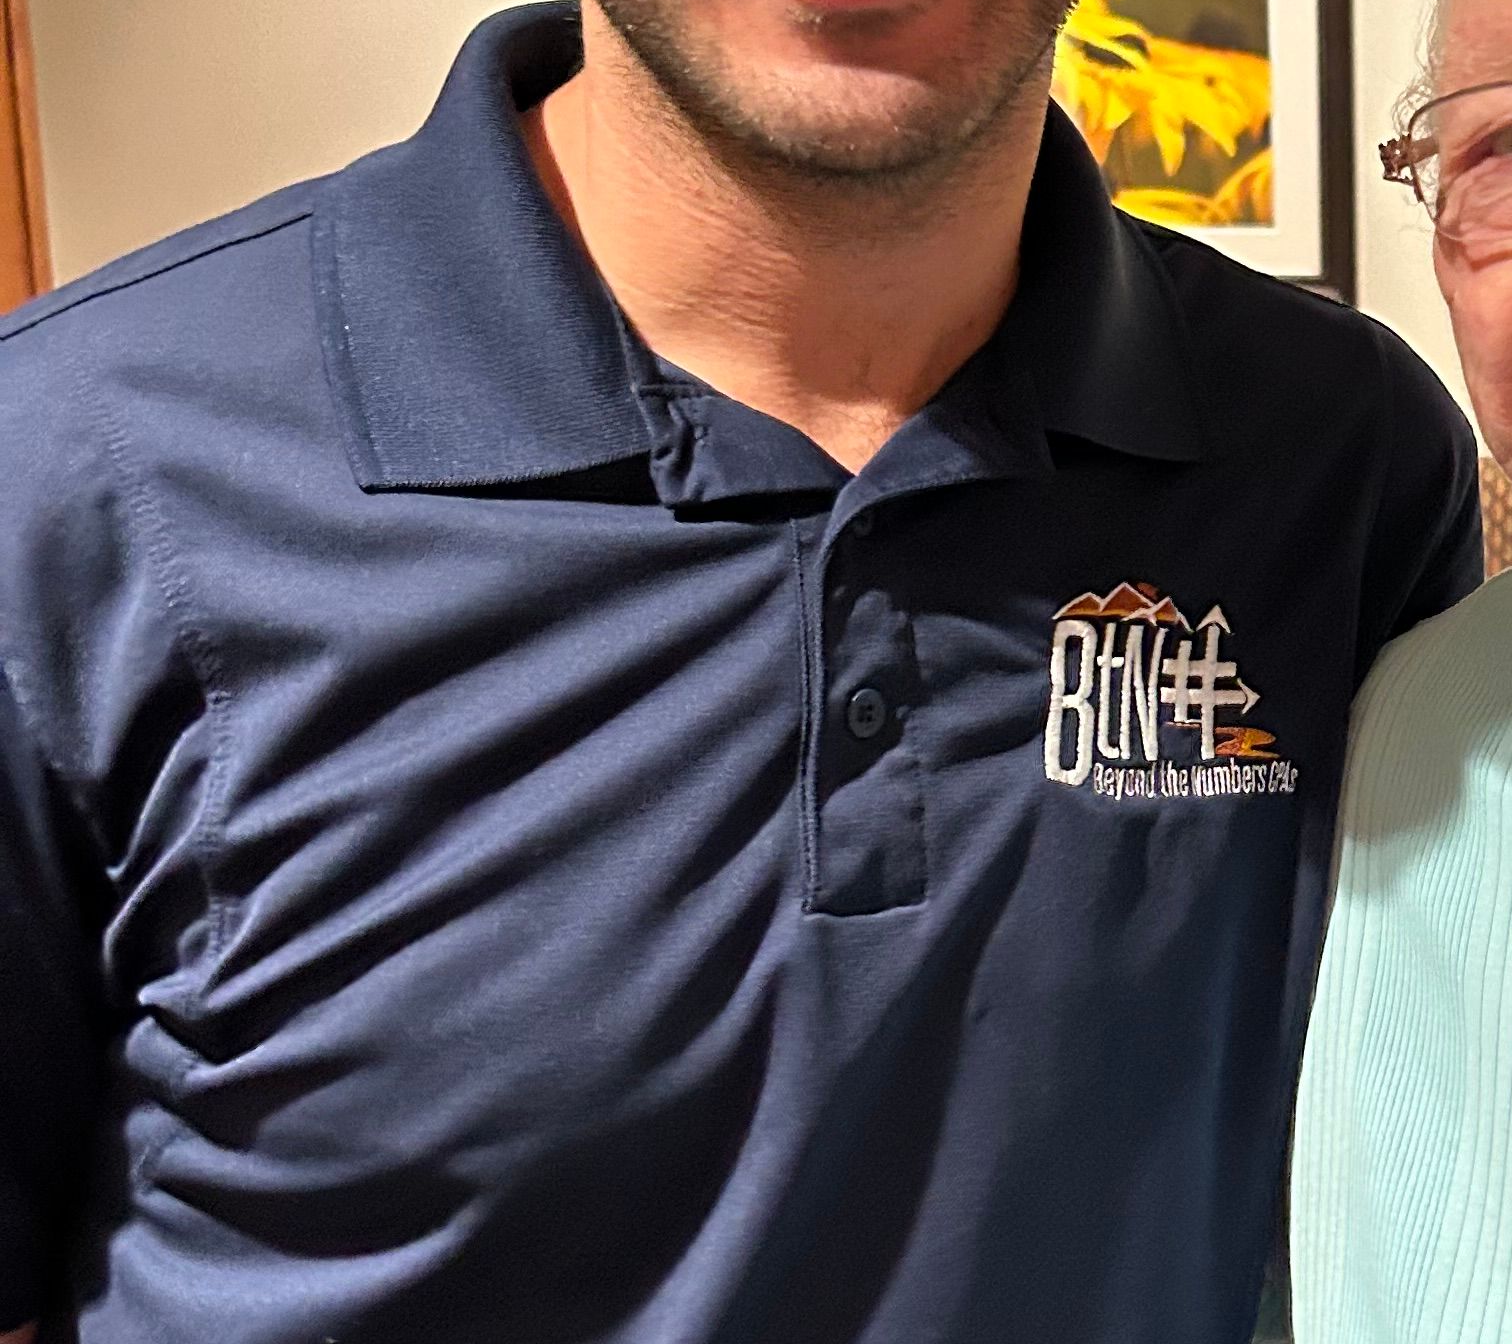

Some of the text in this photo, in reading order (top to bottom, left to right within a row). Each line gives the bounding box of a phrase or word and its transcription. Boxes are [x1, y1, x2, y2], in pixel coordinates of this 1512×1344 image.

[1093, 761, 1156, 801] Beyond
[1160, 759, 1189, 798] the
[1191, 757, 1267, 797] Numbers
